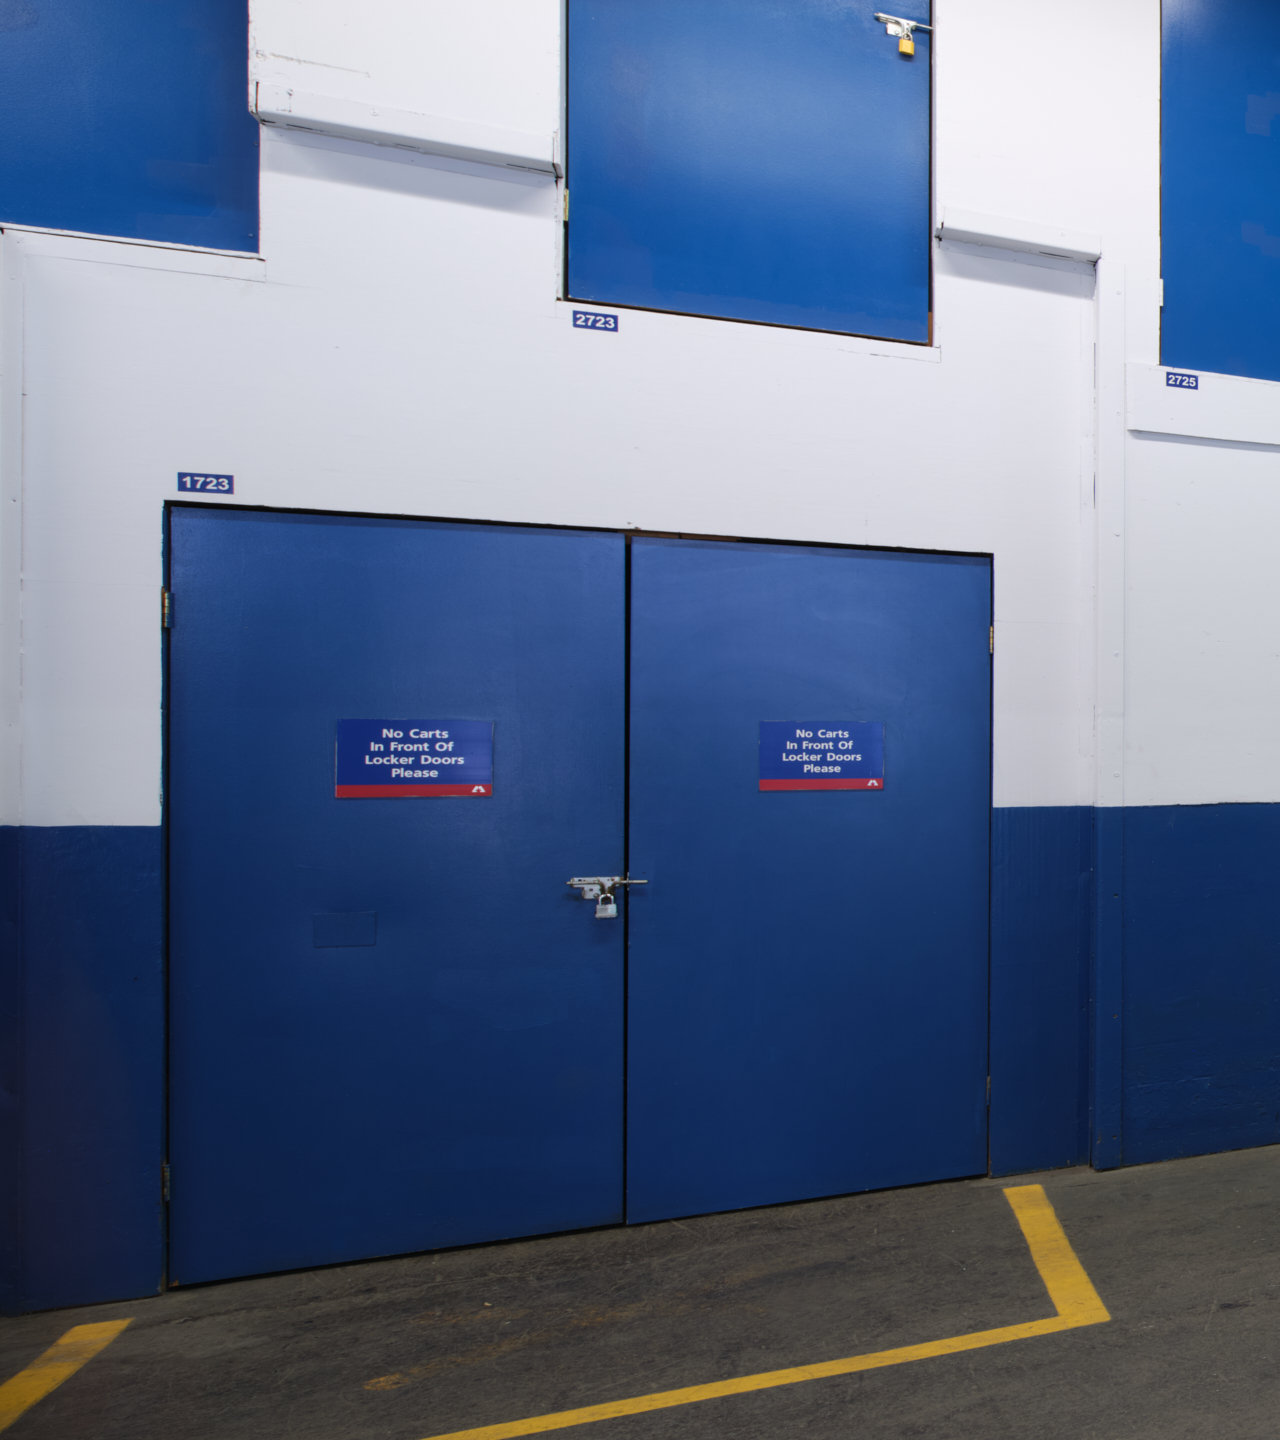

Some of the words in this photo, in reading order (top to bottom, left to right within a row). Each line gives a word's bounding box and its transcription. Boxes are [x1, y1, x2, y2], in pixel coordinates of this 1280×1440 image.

[575, 313, 616, 329] 2723
[1168, 374, 1197, 387] 2725
[181, 475, 231, 491] 1723
[382, 728, 404, 739] No
[409, 728, 449, 739] Carts
[795, 729, 814, 739] No
[817, 729, 850, 739] Carts
[370, 741, 384, 752] In
[390, 741, 430, 752] Front
[435, 741, 455, 752] Of
[786, 741, 798, 750] In
[802, 740, 834, 750] Front
[838, 740, 854, 750] Of
[364, 754, 415, 765] Locker
[420, 754, 465, 765] Doors
[782, 752, 823, 762] Locker
[826, 752, 862, 762] Doors
[391, 767, 439, 778] Please
[803, 764, 842, 774] Please
